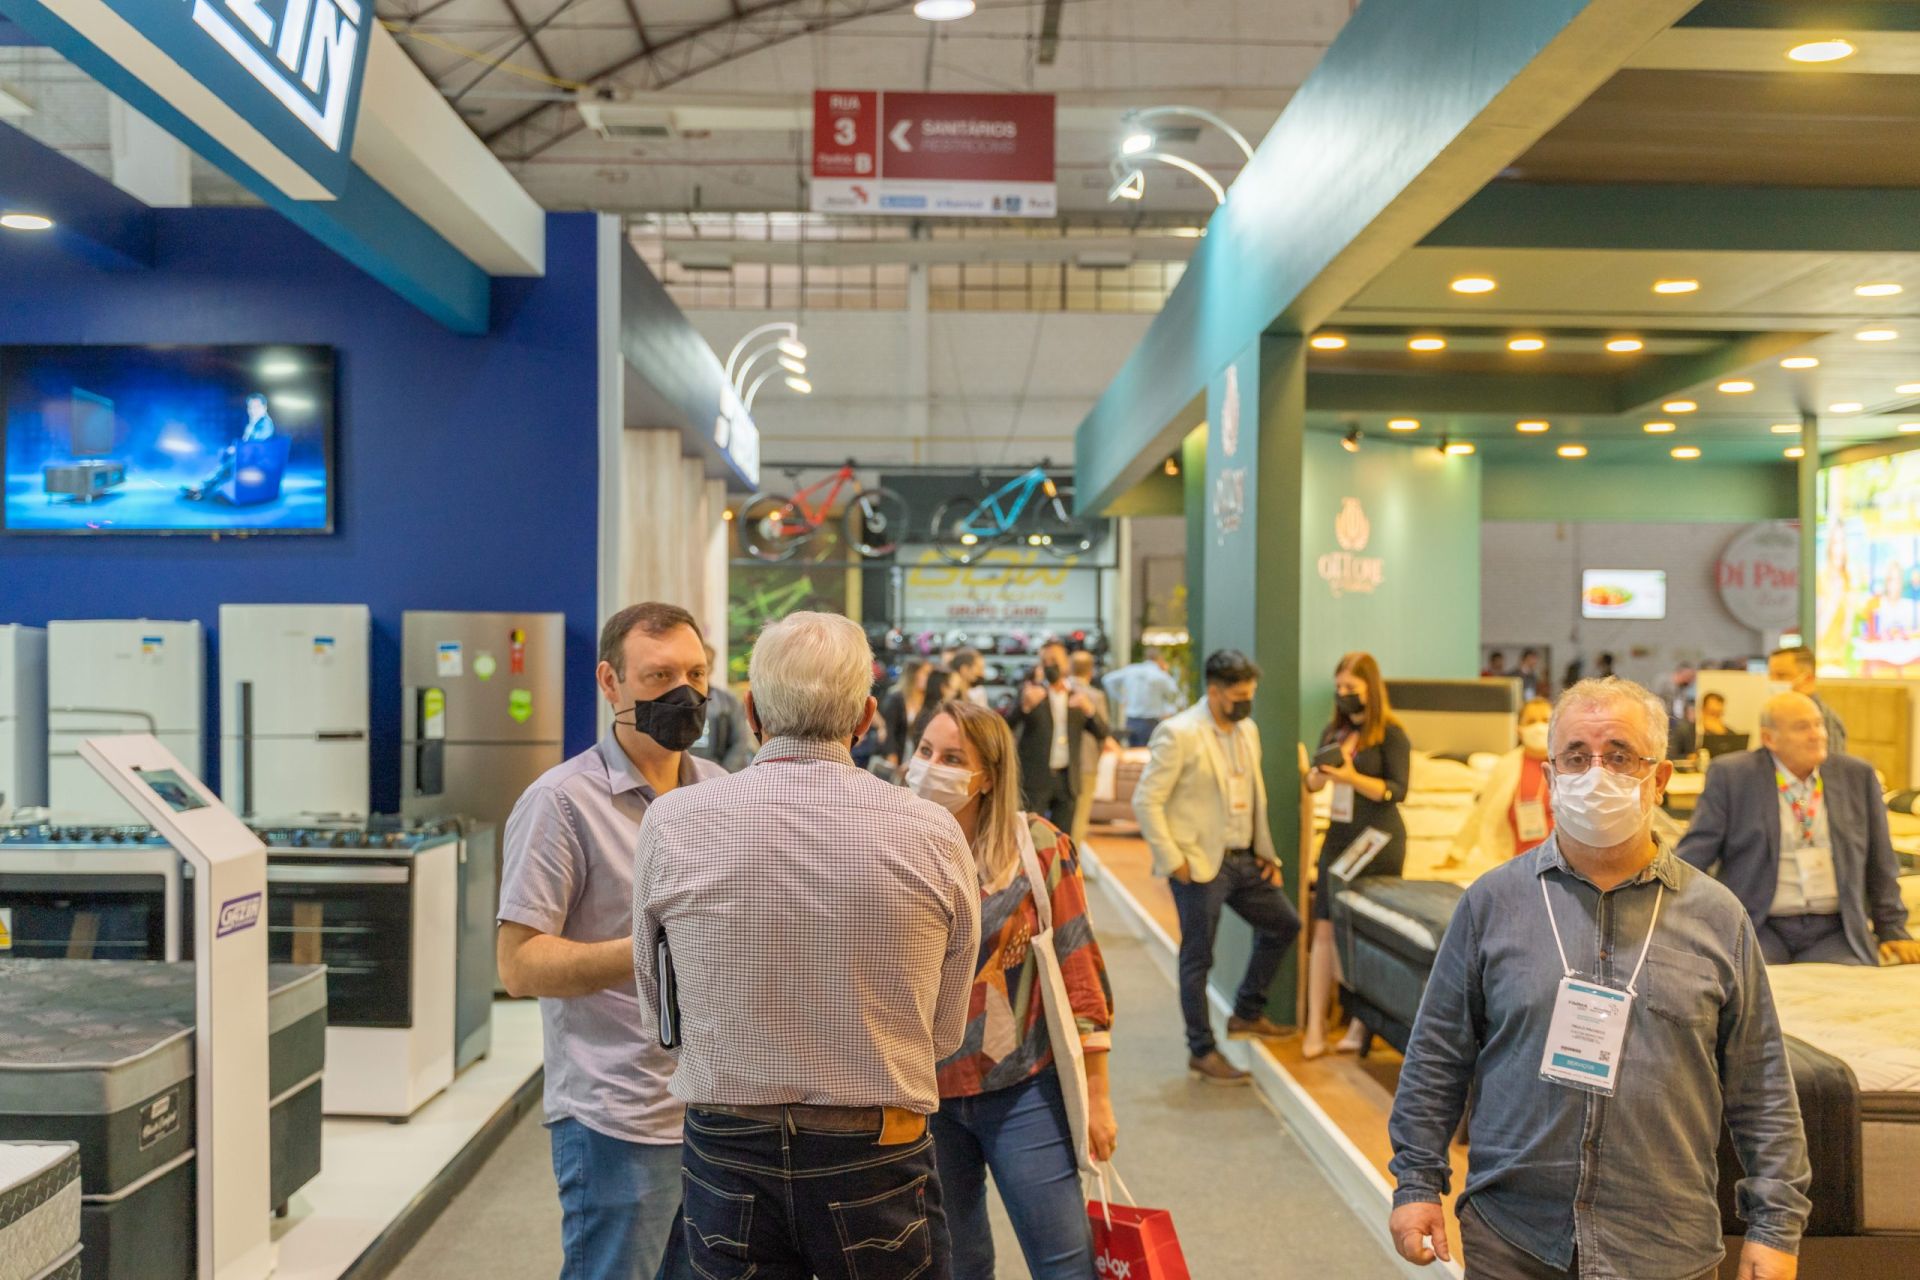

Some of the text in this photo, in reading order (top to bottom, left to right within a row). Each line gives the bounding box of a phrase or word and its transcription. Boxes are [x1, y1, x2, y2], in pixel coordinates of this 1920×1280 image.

[828, 95, 861, 109] RUA
[833, 117, 857, 146] 3
[854, 152, 872, 174] B
